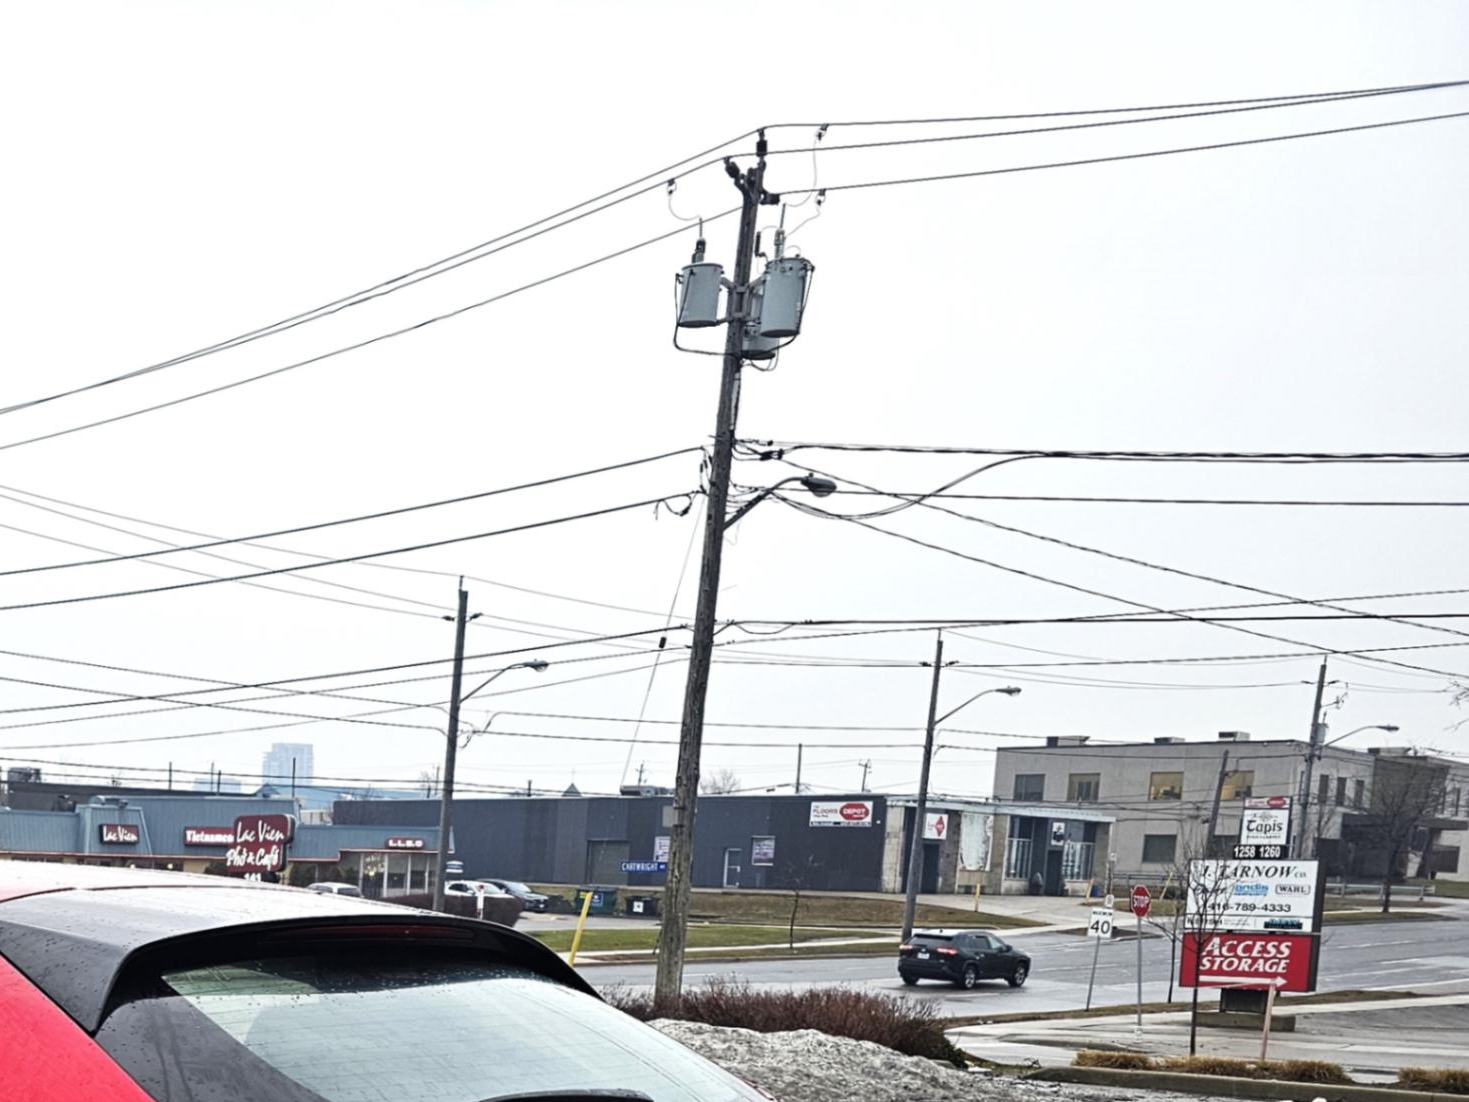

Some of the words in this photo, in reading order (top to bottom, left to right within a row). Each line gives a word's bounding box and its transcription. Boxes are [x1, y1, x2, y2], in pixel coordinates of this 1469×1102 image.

[102, 826, 116, 842] Lac
[118, 827, 138, 842] Vien
[237, 821, 255, 843] Lac
[258, 820, 284, 843] Vien
[1246, 819, 1284, 835] Tapis
[1234, 846, 1256, 858] 1258
[1259, 846, 1282, 858] 1260
[621, 862, 659, 872] CARTWRIGHT
[1219, 865, 1296, 879] TARNOW
[1279, 885, 1307, 893] WAHL
[1133, 895, 1149, 908] STOP
[1090, 920, 1111, 935] 40
[1201, 937, 1293, 958] ACCESS
[1199, 956, 1290, 973] STORAGE
